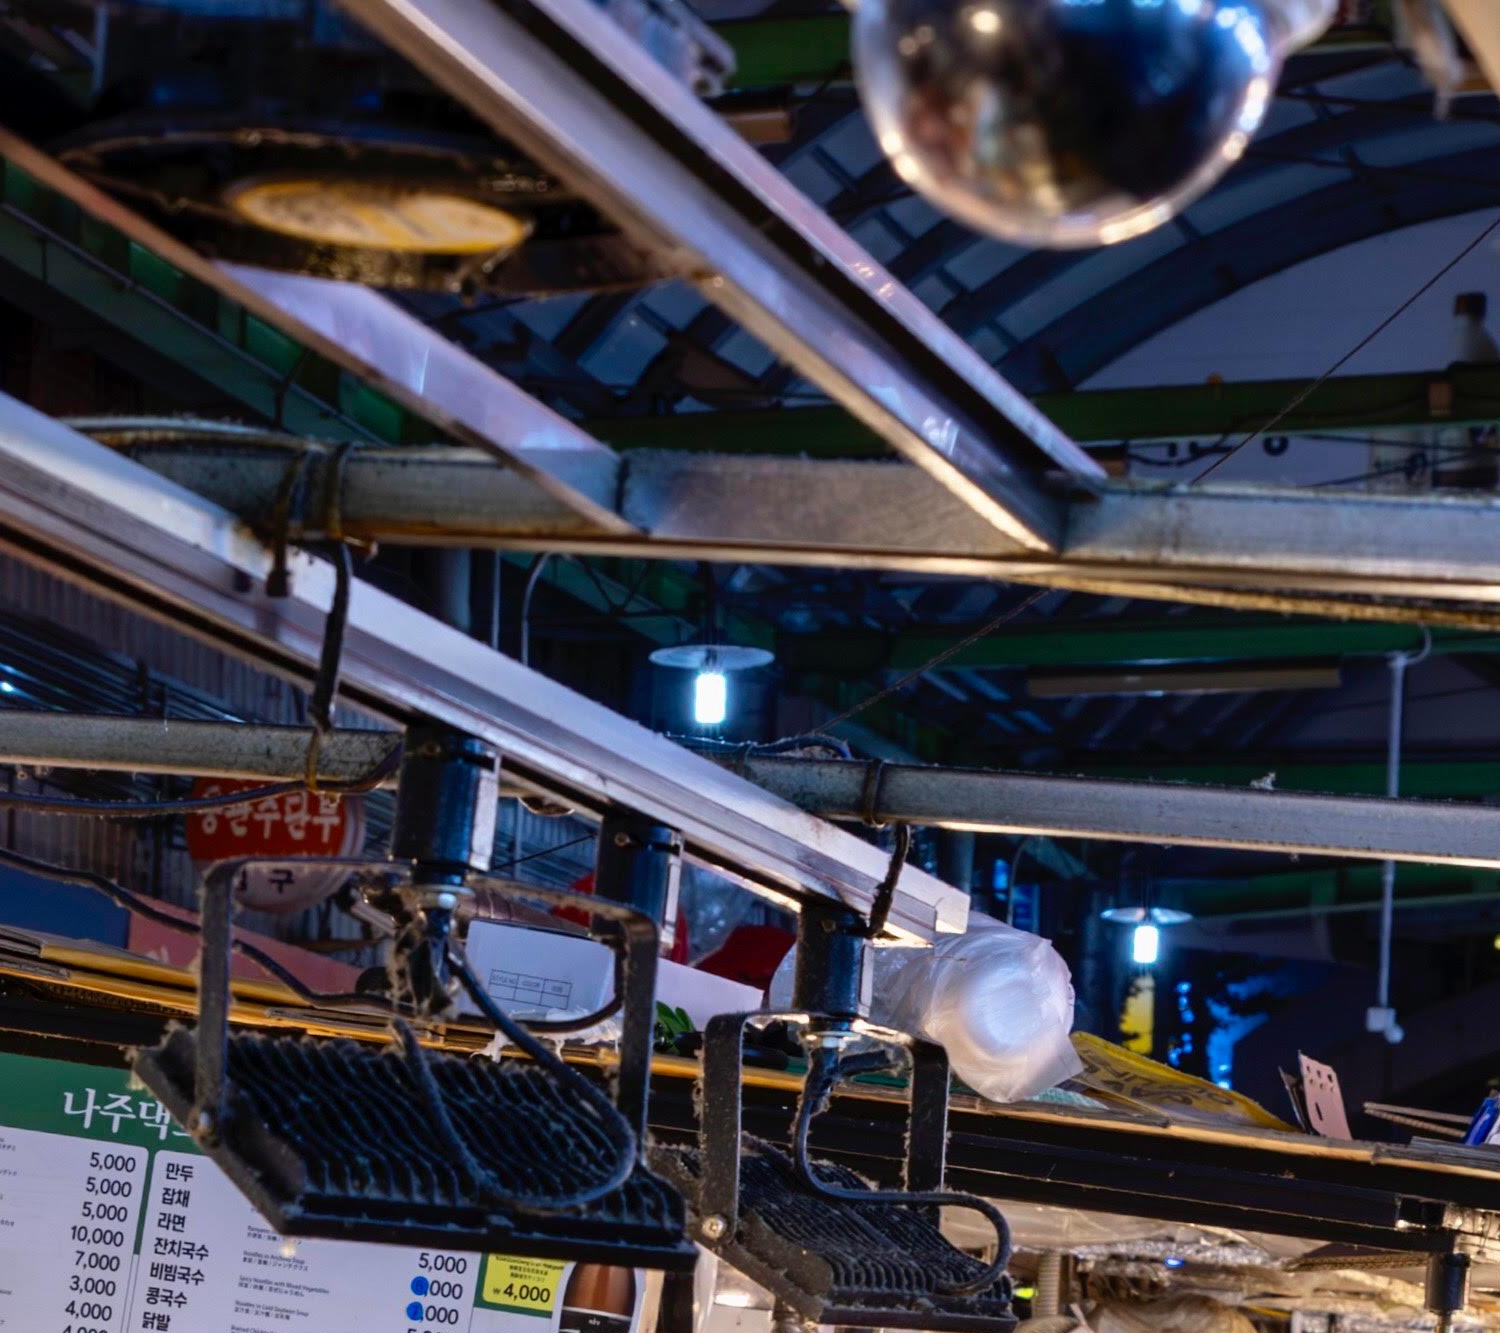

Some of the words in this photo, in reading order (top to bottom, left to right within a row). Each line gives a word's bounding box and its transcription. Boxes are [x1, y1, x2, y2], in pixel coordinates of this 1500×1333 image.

[90, 1151, 136, 1174] 5,000
[165, 1162, 194, 1181] 만두
[86, 1176, 132, 1199] 5,000
[161, 1187, 191, 1208] 잡채
[82, 1200, 128, 1224] 5,000
[157, 1212, 186, 1233] 라면
[70, 1225, 124, 1248] 10,000
[153, 1237, 209, 1261] 잔치국수
[75, 1250, 120, 1274] 7,000
[418, 1252, 467, 1275] 5,000
[150, 1262, 205, 1286] 비빔국수
[69, 1275, 116, 1298] 3,000
[145, 1287, 188, 1309] 콩국수
[503, 1283, 551, 1304] 4,000
[65, 1300, 112, 1323] 4,000
[142, 1311, 171, 1333] 닭발
